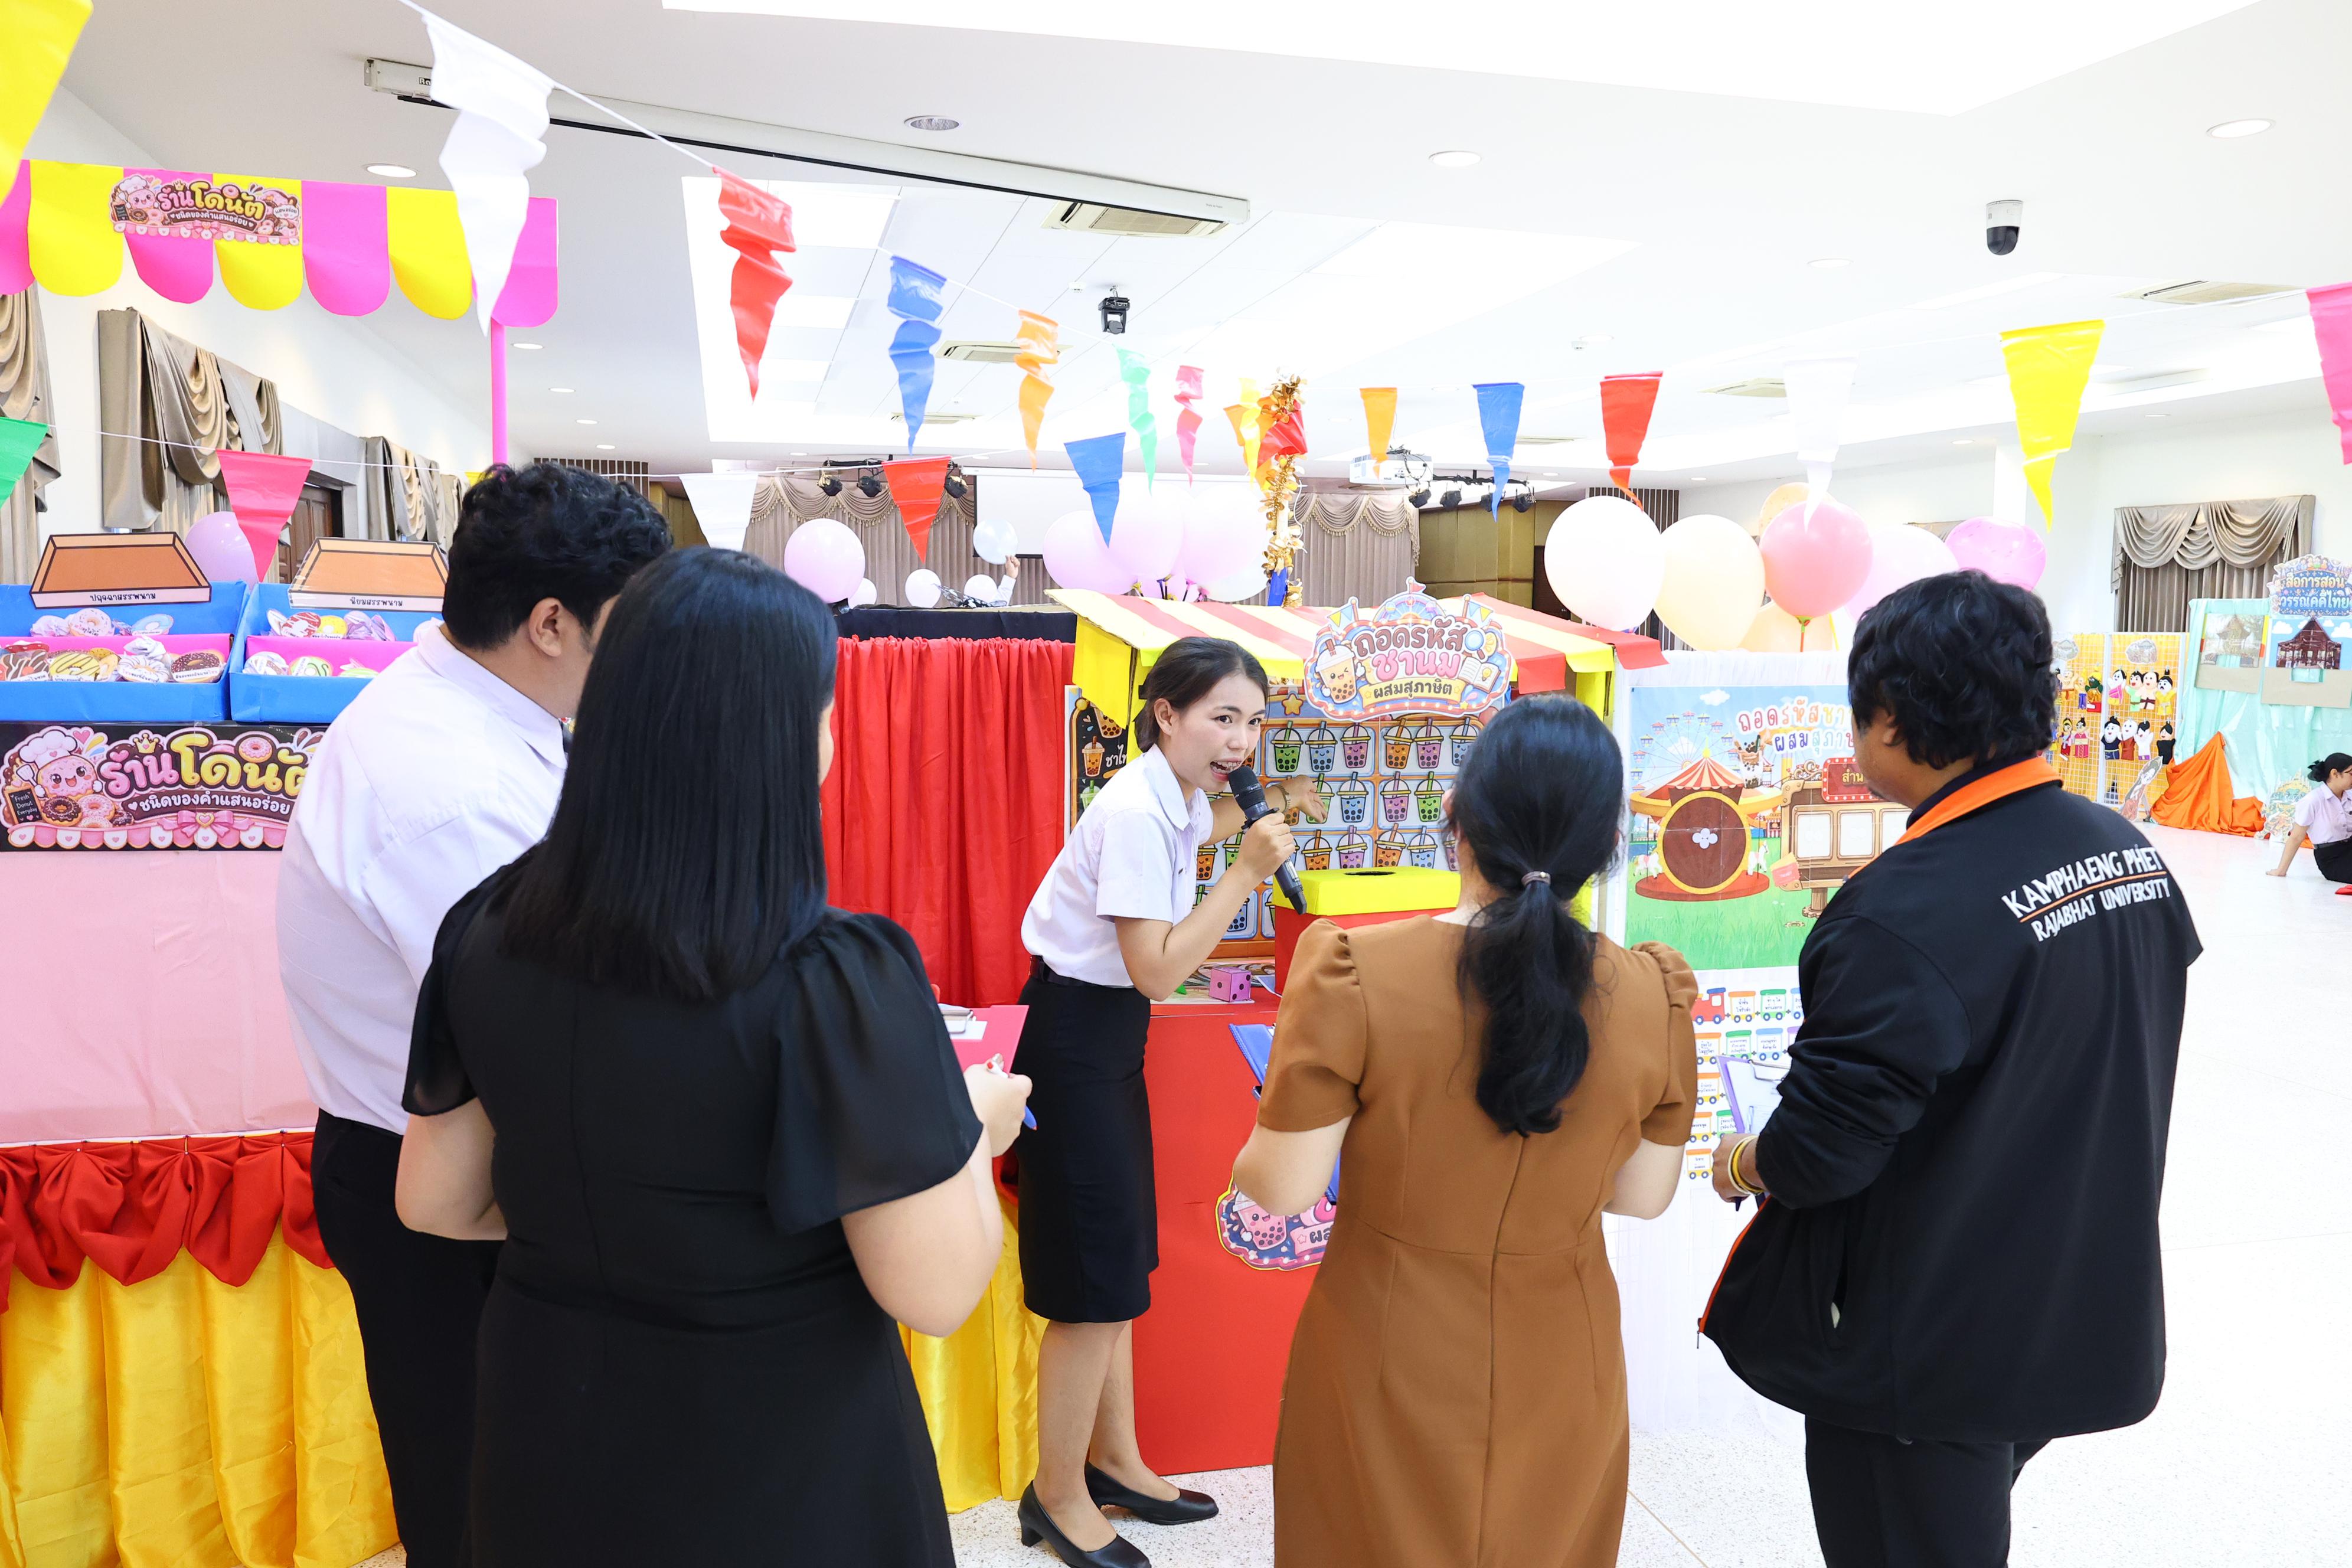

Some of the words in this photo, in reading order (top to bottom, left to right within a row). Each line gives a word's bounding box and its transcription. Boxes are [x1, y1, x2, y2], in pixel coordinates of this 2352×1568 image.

[157, 181, 265, 220] ร้านโดนัต
[175, 211, 249, 227] ชนิดของคำแสนอร่อย
[2285, 571, 2345, 588] สื่อการสอน
[1354, 617, 1468, 656] ถอดรหัส
[1371, 649, 1461, 681] ชานม
[1373, 679, 1452, 698] ผสมสุภาษิต
[1739, 700, 1854, 731] ถอดรหัสชา
[14, 794, 30, 802] Fresh
[17, 807, 37, 815] Everyday
[139, 791, 290, 815] ชนิดของคำแสนอร่อย
[2001, 851, 2124, 919] KAMPHAENG
[2121, 846, 2163, 875] PHET
[2031, 894, 2096, 942] RAJABHAT
[2099, 878, 2171, 911] UNIVERSITY
